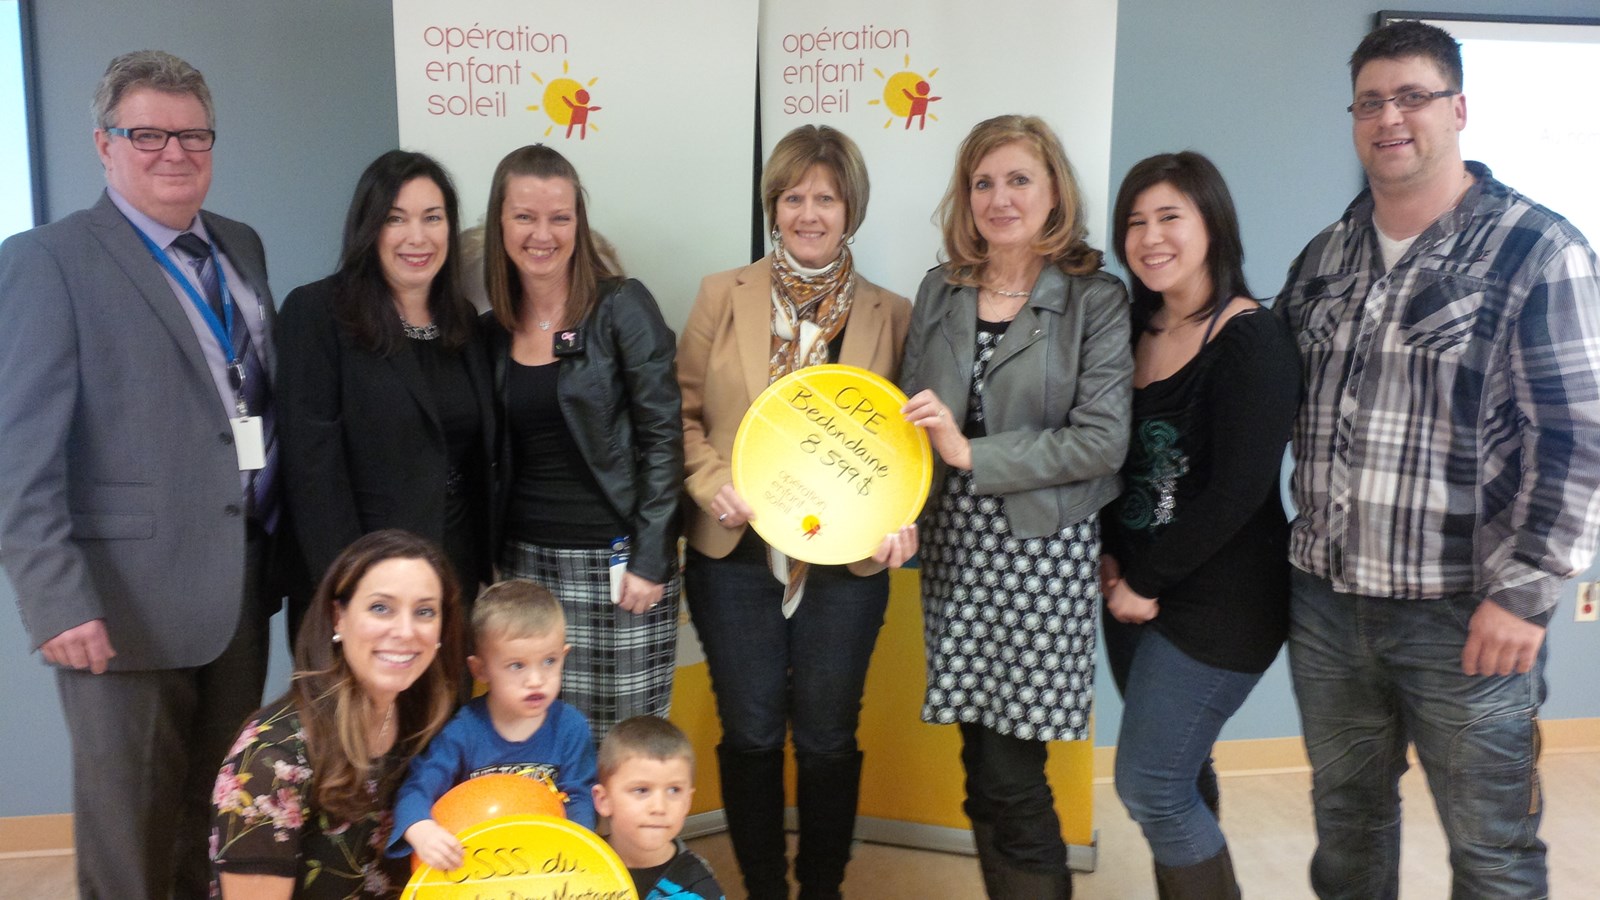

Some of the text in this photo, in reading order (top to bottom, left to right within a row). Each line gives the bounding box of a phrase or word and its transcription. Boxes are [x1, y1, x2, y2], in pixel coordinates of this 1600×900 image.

[424, 22, 568, 54] opération
[782, 25, 910, 59] opération
[425, 57, 522, 86] enfant
[783, 58, 865, 85] enfant
[427, 91, 506, 117] soleil
[783, 89, 849, 115] soleil
[834, 386, 888, 436] CPE
[788, 386, 890, 478] Bedondaine
[800, 433, 821, 454] 8
[541, 851, 588, 874] du
